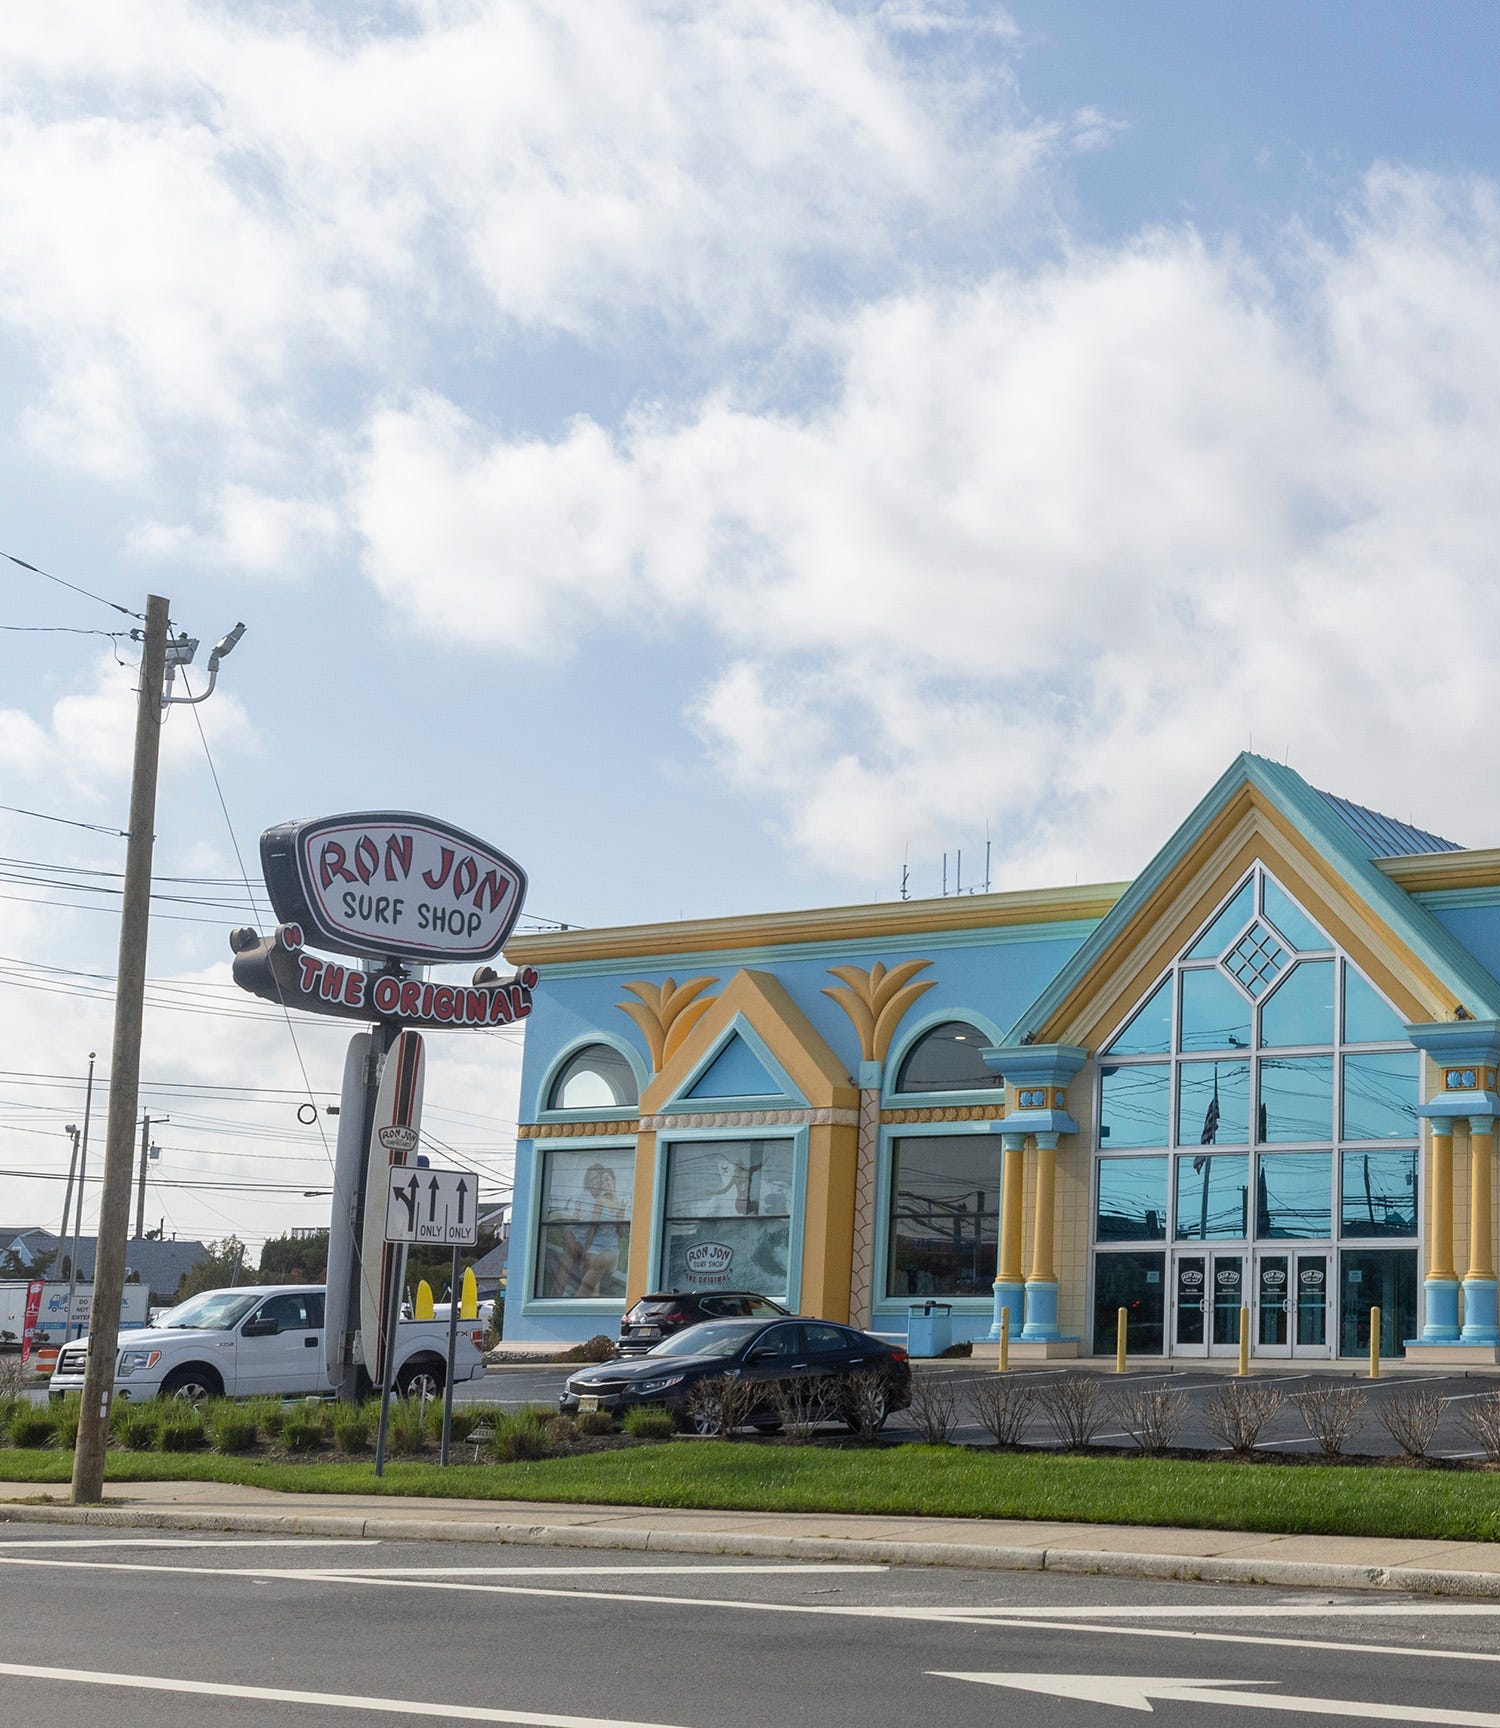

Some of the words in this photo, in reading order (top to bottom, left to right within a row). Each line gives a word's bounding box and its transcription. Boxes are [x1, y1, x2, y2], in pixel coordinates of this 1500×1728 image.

[319, 833, 413, 892] RON
[421, 846, 510, 914] JON
[342, 891, 404, 925] SURF
[417, 902, 482, 938] SHOP
[382, 1129, 400, 1140] RON
[401, 1131, 416, 1142] JON
[420, 1224, 442, 1237] ONLY
[449, 1226, 472, 1239] ONLY
[688, 1246, 708, 1262] RON
[710, 1247, 730, 1261] JON
